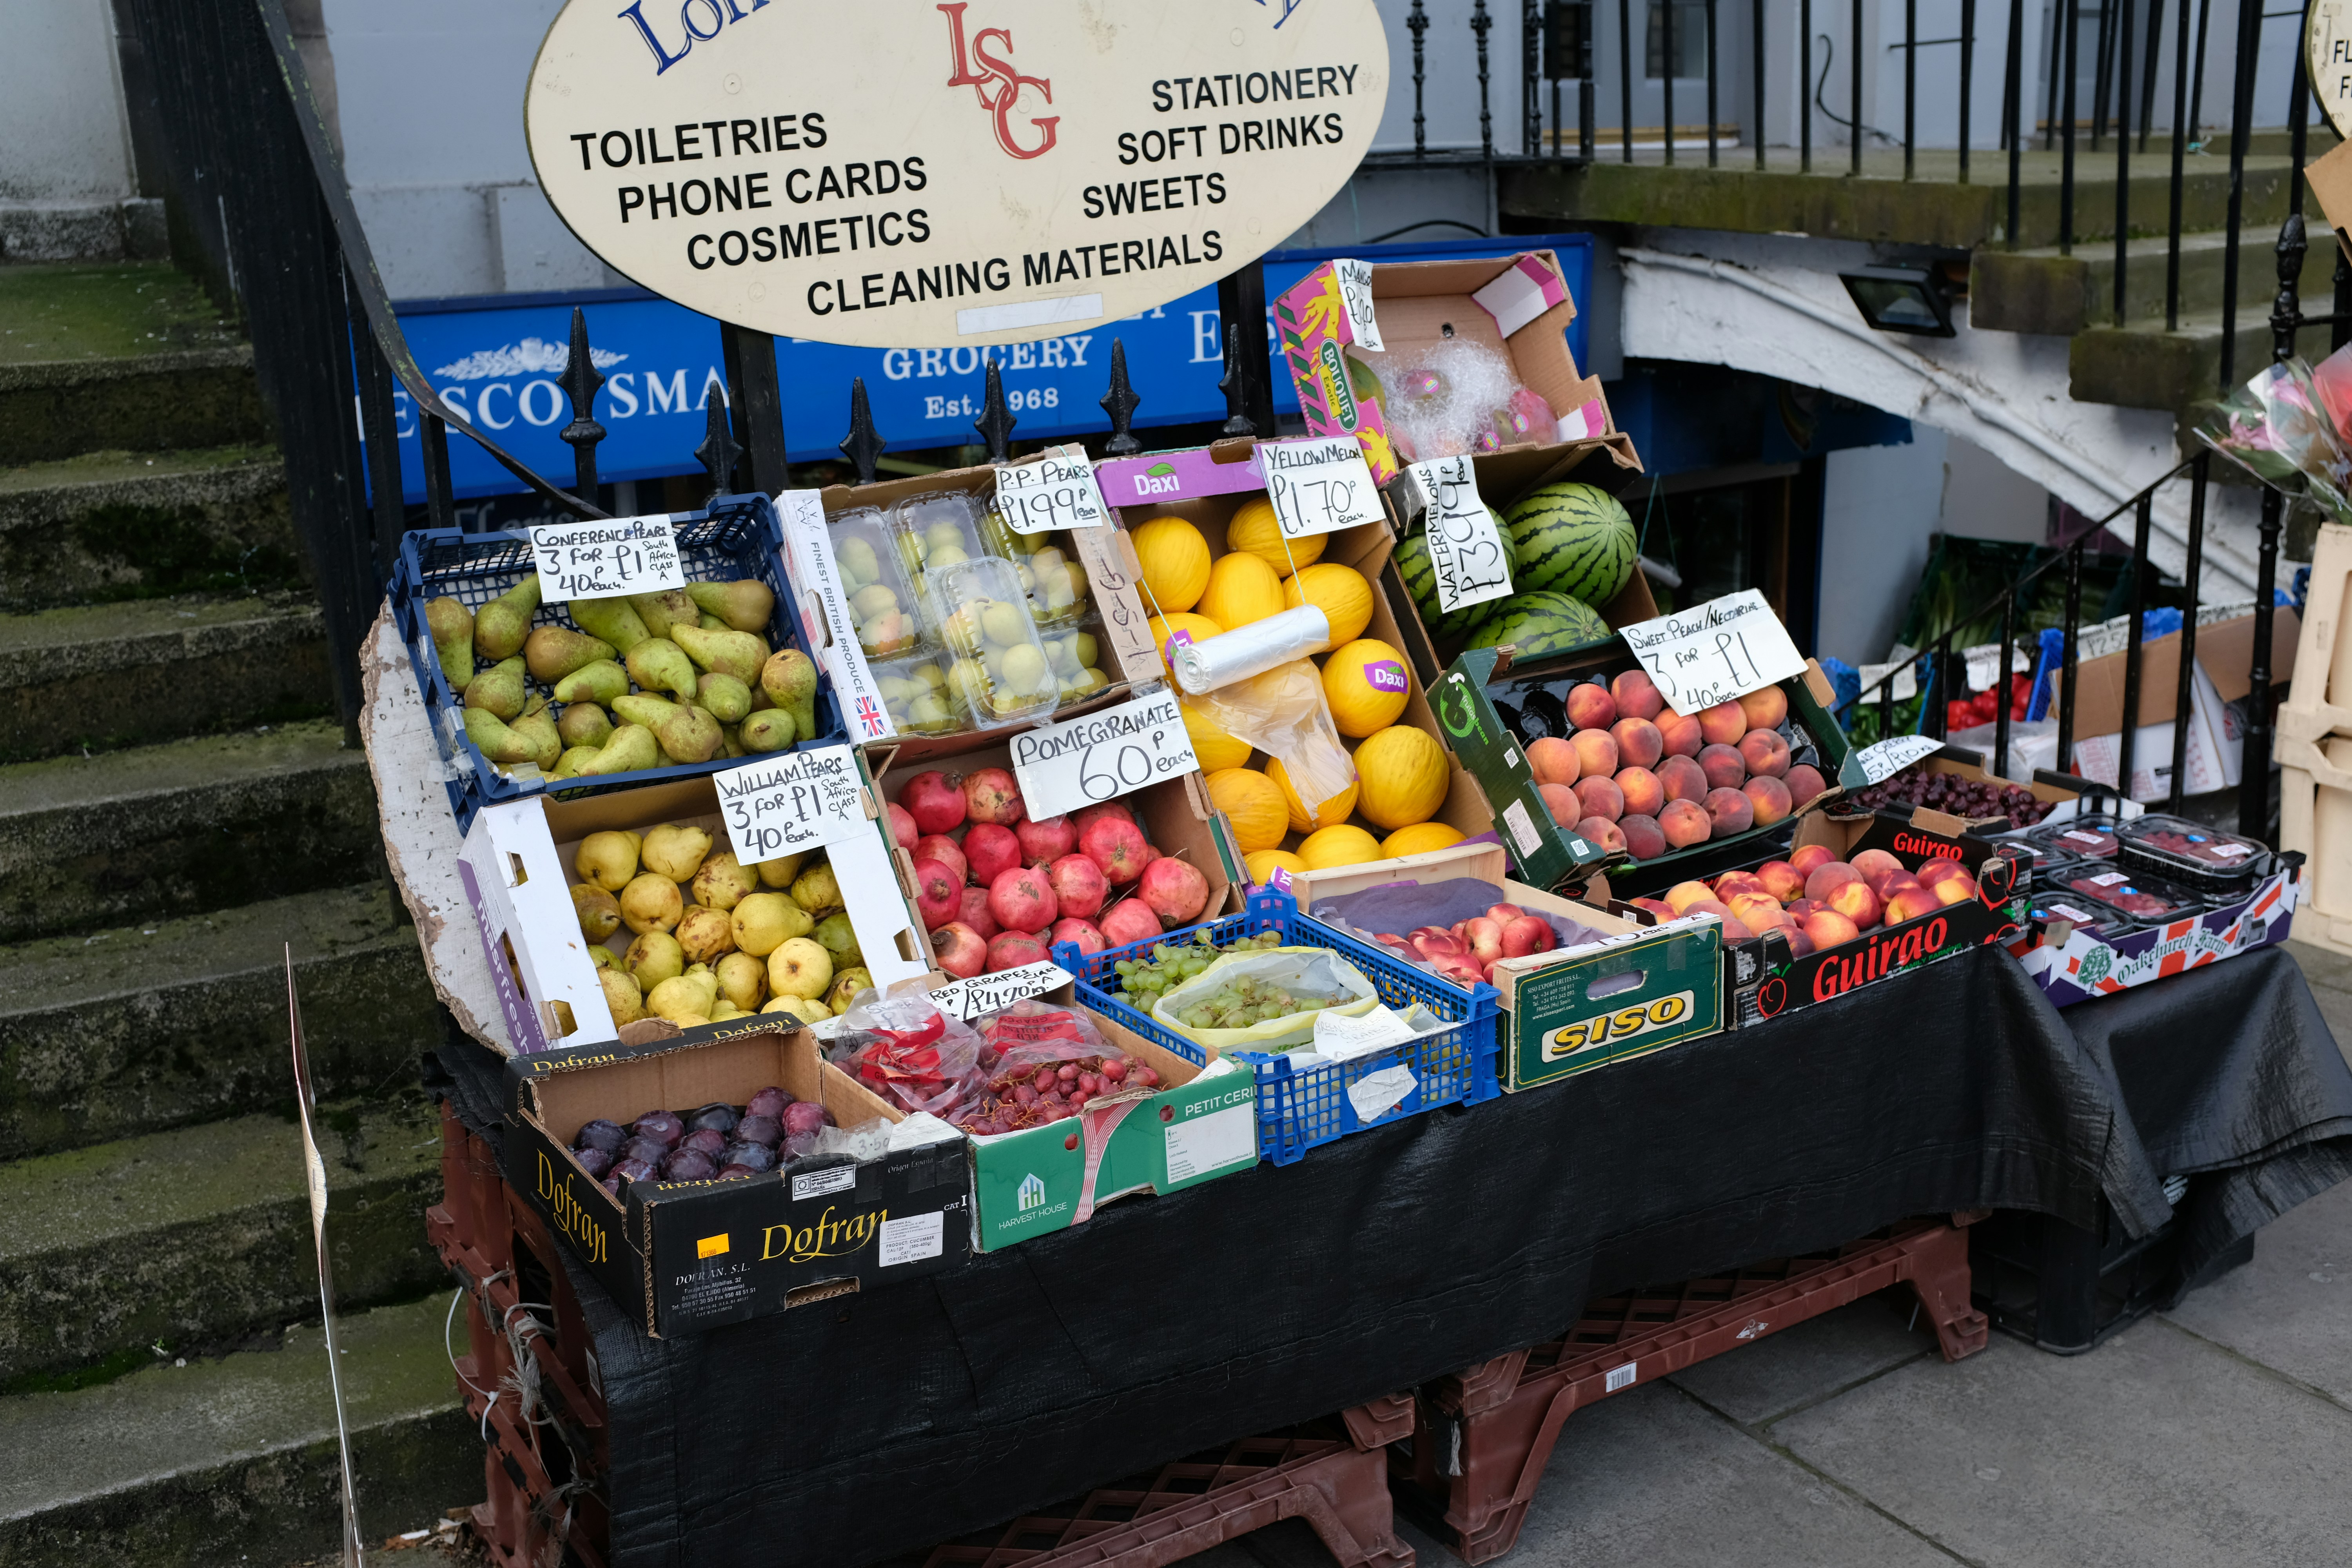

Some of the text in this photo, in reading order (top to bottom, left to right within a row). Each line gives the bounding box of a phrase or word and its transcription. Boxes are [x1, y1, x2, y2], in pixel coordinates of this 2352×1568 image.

[1152, 64, 1359, 112] STATIONERY
[571, 113, 827, 170] TOILETRIES
[1118, 113, 1343, 165] SOFT DRINKS
[618, 157, 927, 223] PHONE CARDS
[1083, 172, 1226, 219] SWEETS
[688, 209, 930, 270] COSMETICS
[807, 230, 1222, 316] CLEANING MATERIALS
[1324, 347, 1354, 422] BOUQUET
[1324, 376, 1335, 407] Exotic
[925, 394, 981, 419] Est.
[1265, 444, 1361, 470] YELLOW MELON
[1041, 461, 1089, 485] PEARS
[1133, 475, 1180, 495] Daxi
[534, 521, 666, 546] CONFERENCE PEARS
[539, 550, 561, 575] 3
[608, 545, 642, 580] £1
[660, 571, 669, 581] A
[811, 542, 865, 693] FINEST BRITISH PRODUCE
[1628, 628, 1665, 649] SWEET
[1375, 669, 1404, 688] Daxi
[1641, 653, 1676, 697] 3
[1711, 632, 1761, 687] £1
[1463, 695, 1476, 720] frutas
[1018, 702, 1178, 766] POMEGRANATE
[1475, 717, 1489, 745] bean
[717, 751, 842, 797] WILLIAM PEARS
[726, 801, 750, 829] 3
[790, 785, 822, 822] £1
[838, 810, 849, 820] A
[1893, 832, 1963, 861] Guirao
[1813, 917, 1947, 1003] Guirao
[929, 969, 1029, 1001] RED GRAPES
[1042, 976, 1054, 984] A
[1538, 981, 1555, 990] EXPORT
[1556, 976, 1572, 985] FRUITS
[1532, 1004, 1575, 1020] www.sisoexport.com
[1551, 997, 1685, 1056] SISO
[1185, 1097, 1221, 1117] PETIT
[888, 1163, 909, 1174] Origen
[1212, 1151, 1252, 1167] www.harvesthouse.nl
[537, 1148, 607, 1263] Dofran
[944, 1194, 967, 1210] CAT I
[998, 1202, 1067, 1230] HARVEST HOUSE
[758, 1206, 888, 1263] Dofran
[910, 1235, 934, 1243] CUCUMBER
[706, 1288, 721, 1296] EJIDO
